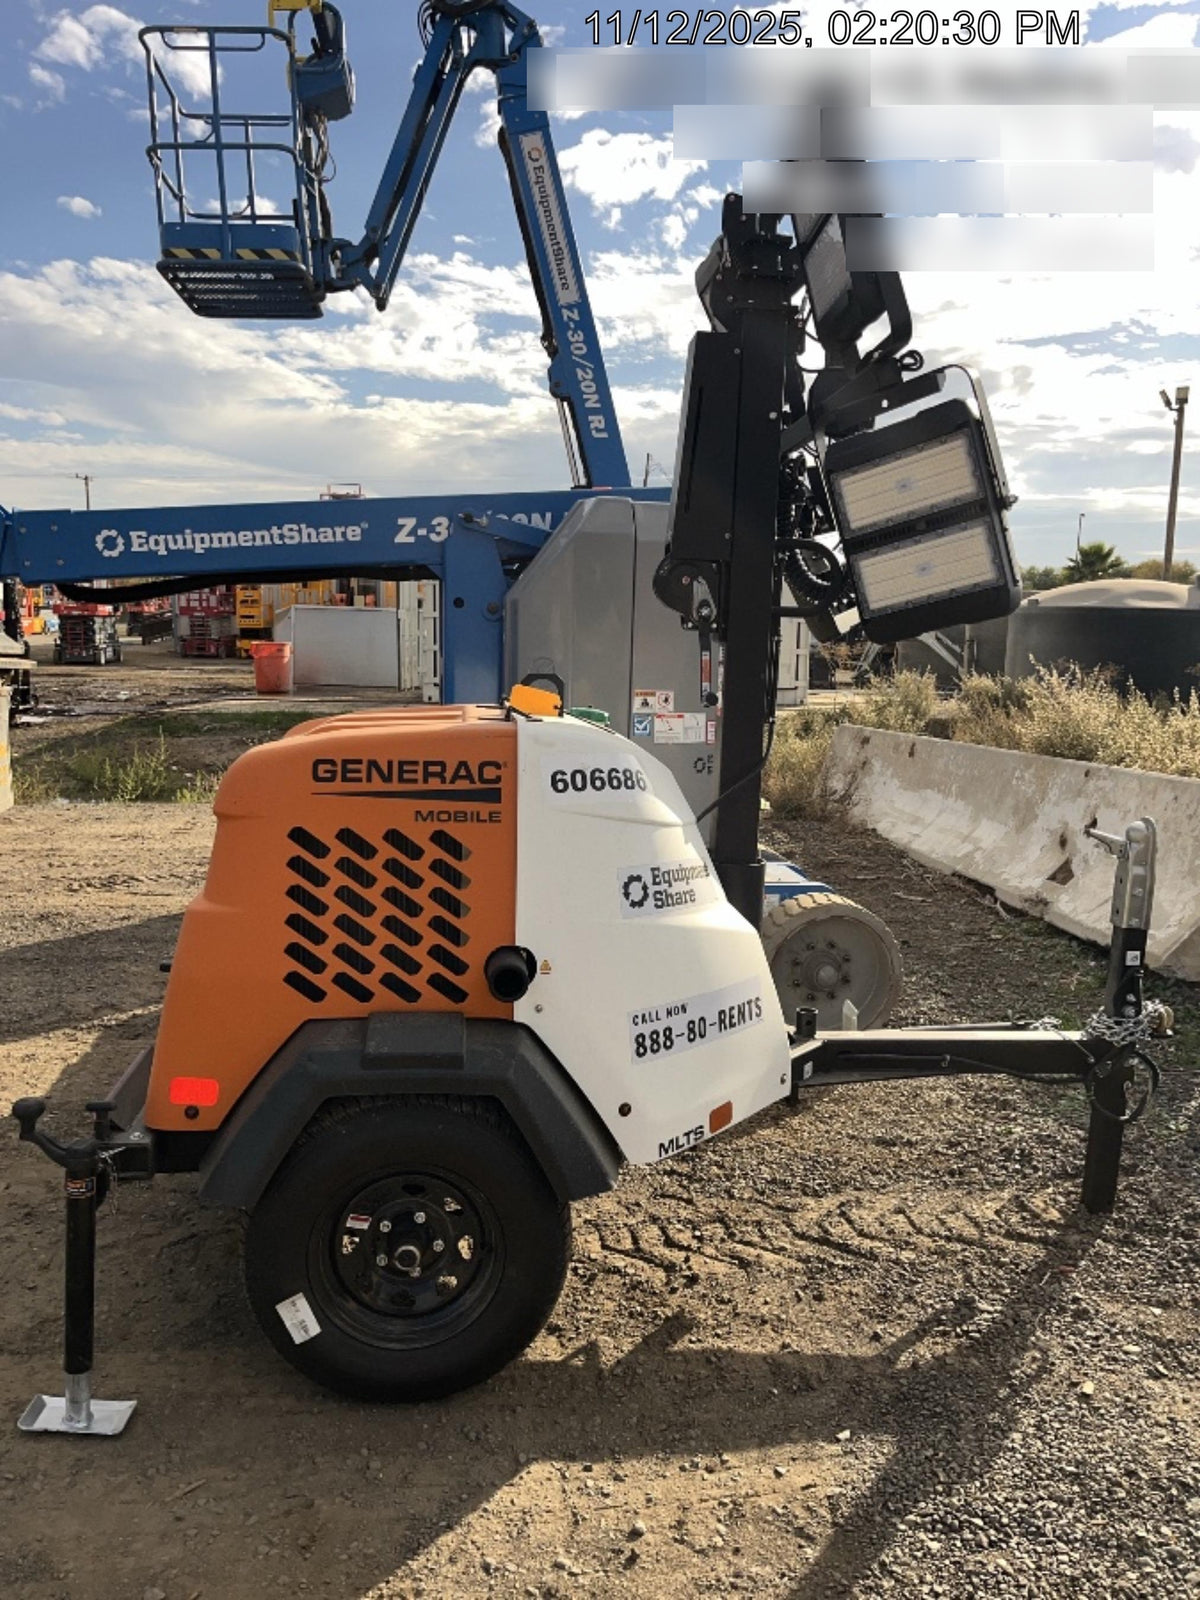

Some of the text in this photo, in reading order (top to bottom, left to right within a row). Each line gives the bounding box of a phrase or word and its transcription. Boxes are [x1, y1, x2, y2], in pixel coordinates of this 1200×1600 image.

[532, 165, 570, 291] EquipmentShare
[561, 307, 609, 439] Z-30/20N RJ
[128, 522, 363, 556] EquipmentShare
[311, 758, 502, 785] GENERAC
[550, 767, 647, 793] 606686
[414, 810, 502, 824] MOBILE
[653, 888, 696, 909] Share
[632, 1009, 662, 1026] CALL
[634, 997, 763, 1058] 888-80-RENTS
[658, 1125, 706, 1158] MLTS
